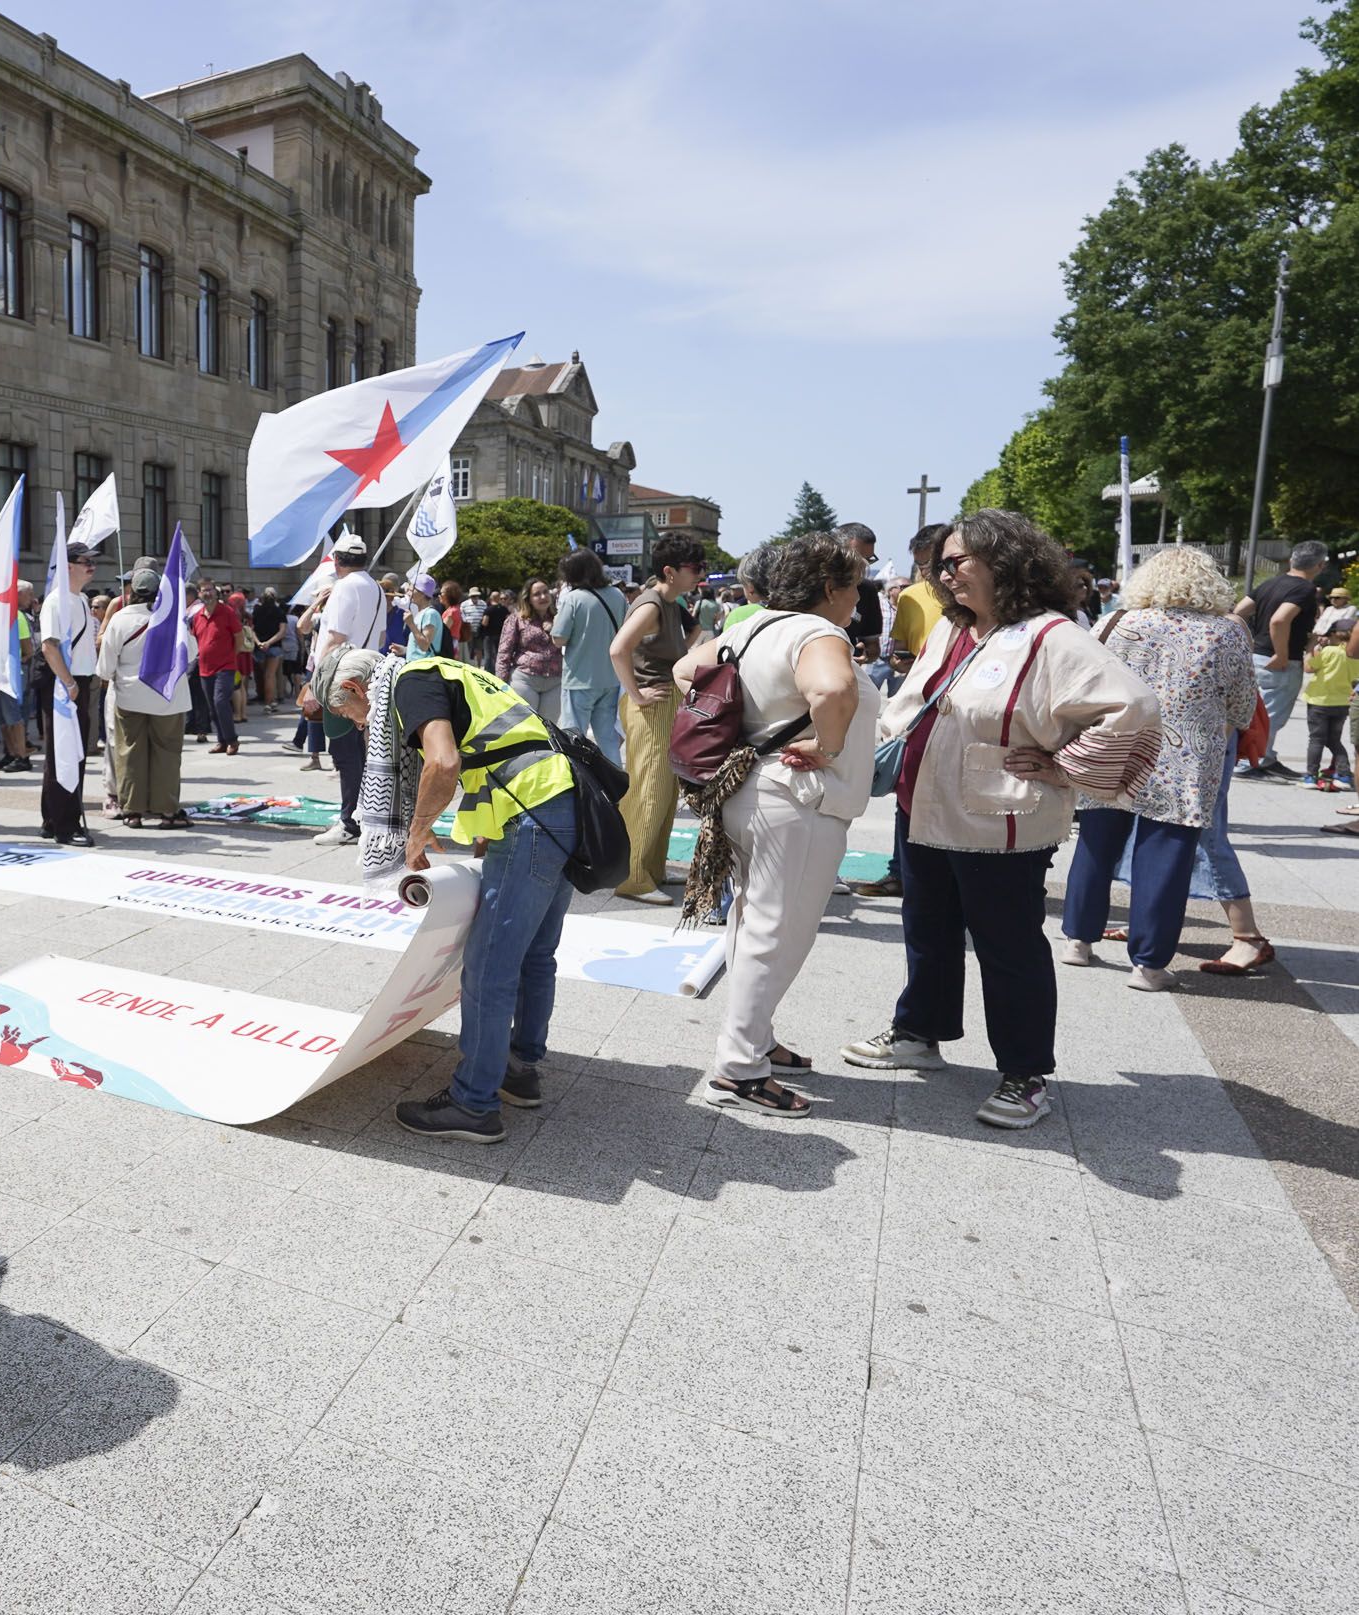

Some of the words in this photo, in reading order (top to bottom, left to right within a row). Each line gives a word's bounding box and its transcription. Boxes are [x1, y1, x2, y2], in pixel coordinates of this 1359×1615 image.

[125, 869, 313, 901] QUEREMOS
[128, 885, 328, 920] QUEREMOS
[108, 895, 150, 904] Non
[182, 906, 257, 920] espolio
[261, 917, 290, 926] de
[295, 922, 375, 938] Galiza!
[76, 988, 194, 1021] DENDE
[190, 1012, 225, 1029] A
